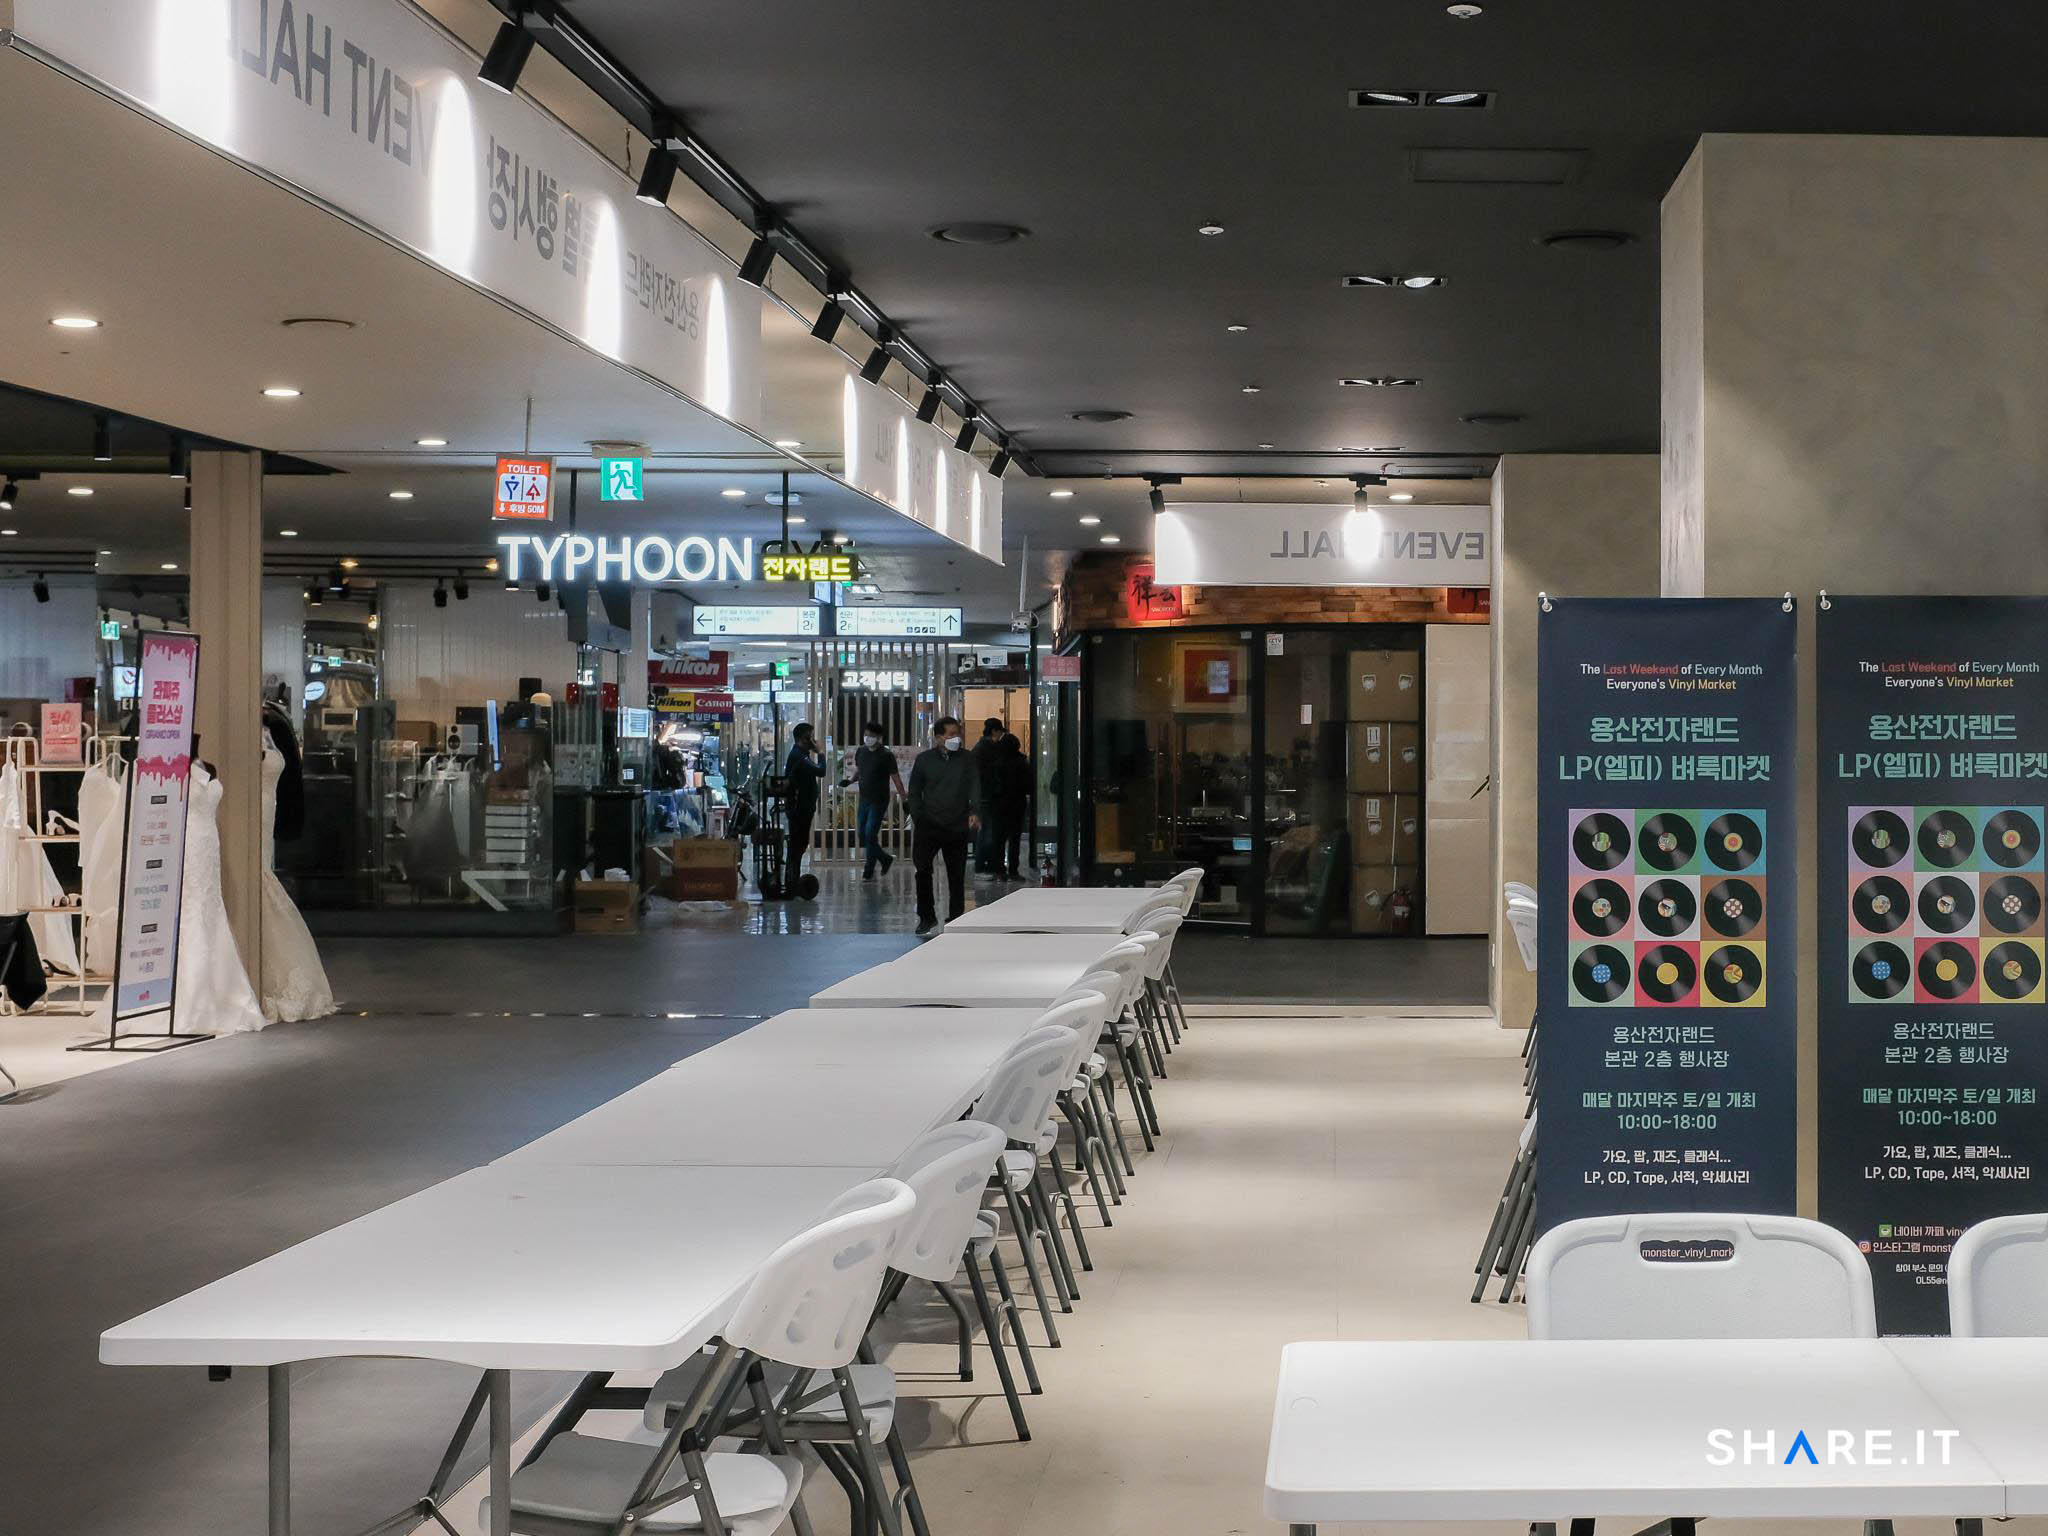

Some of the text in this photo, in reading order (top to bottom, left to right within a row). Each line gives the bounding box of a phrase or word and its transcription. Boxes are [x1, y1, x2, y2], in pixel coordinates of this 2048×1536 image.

[507, 464, 542, 474] TOILET
[527, 505, 545, 513] 50M
[497, 536, 753, 581] TYPHOON
[763, 556, 852, 581] 전자랜드
[660, 659, 720, 676] Nikon
[1580, 663, 1763, 677] The Last Weekend of Every Month
[1859, 661, 2040, 675] The Last Weekend of Every Month
[1606, 678, 1737, 692] Everyone's Vinyl Market
[1885, 676, 2014, 690] Everyone's Vinyl Market
[656, 696, 733, 708] Nikon Canon
[1589, 716, 1740, 743] 용산전자랜드
[1868, 714, 2017, 741] 용산전자랜드
[1559, 755, 1771, 782] LP(엘피) 벼룩마켓
[1838, 752, 2048, 779] LP(엘피) 벼룩마켓
[1613, 1026, 1716, 1044] 용산전자랜드
[1893, 1022, 1995, 1040] 용산전자랜드
[1604, 1051, 1729, 1068] 본관 2층 행사장
[1884, 1047, 2009, 1064] 본관 2층 행사장
[1582, 1092, 1756, 1108] 매달 마지막주 토/일 개최
[1863, 1088, 2036, 1104] 매달 마지막주 토/일 개최
[1617, 1114, 1717, 1130] 10:00~18:00
[1898, 1110, 1997, 1125] 10:00~18:00
[1602, 1150, 1631, 1164] 가요,
[1633, 1150, 1650, 1164] 팝,
[1652, 1150, 1681, 1164] 재즈,
[1883, 1146, 1911, 1160] 가요,
[1914, 1146, 1930, 1160] 팝,
[1933, 1146, 1961, 1160] 재즈,
[1584, 1171, 1750, 1185] LP, CD, Tape, 서적, 악세사리
[1864, 1167, 2030, 1181] LP, CD, Tape, 서적, 악세사리
[1893, 1226, 1968, 1238] 네이버 까페 viny
[1873, 1242, 1921, 1253] 인스타그램
[1912, 1263, 1927, 1272] 부스
